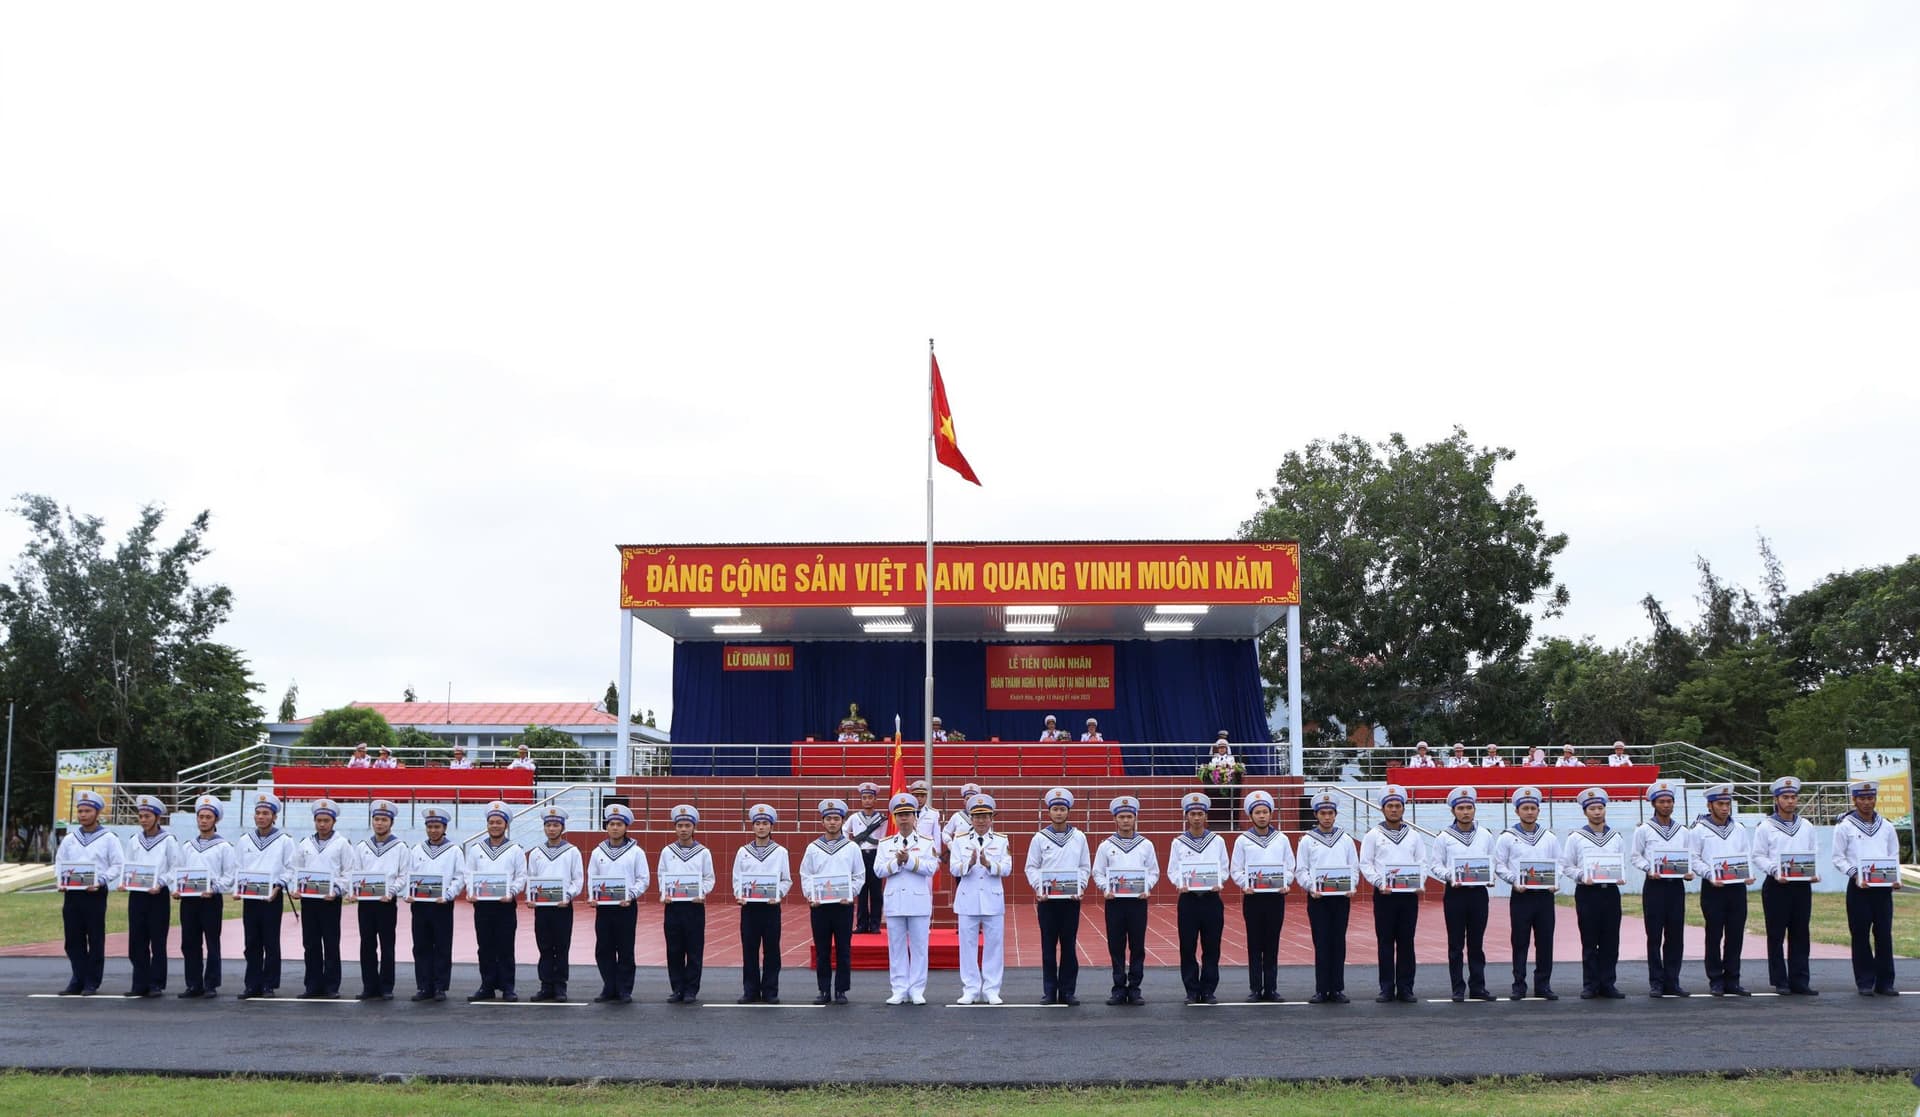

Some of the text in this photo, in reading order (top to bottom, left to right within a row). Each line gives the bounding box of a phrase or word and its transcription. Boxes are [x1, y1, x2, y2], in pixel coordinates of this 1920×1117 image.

[647, 554, 1273, 598] ĐẢNG CỘNG SẢN VIỆT NAM QUANG VINH MUÔN NĂM
[773, 653, 790, 666] 101
[1042, 656, 1065, 670] QUÂN
[1067, 656, 1092, 669] NHÂN
